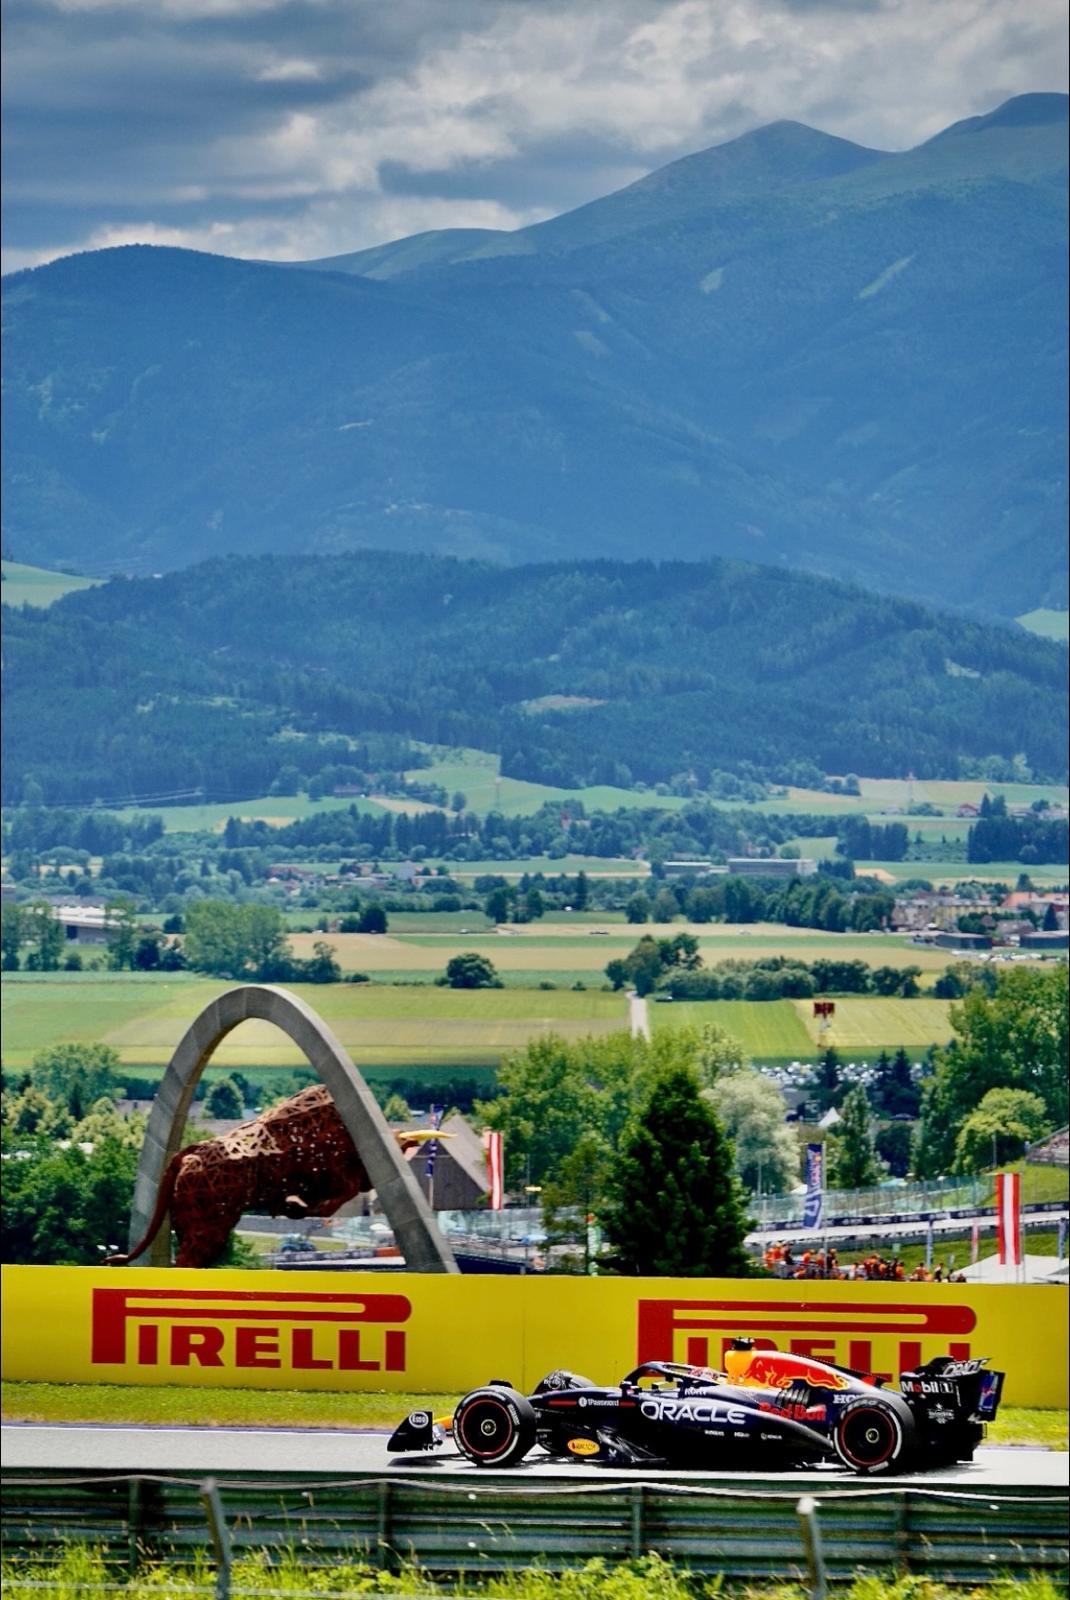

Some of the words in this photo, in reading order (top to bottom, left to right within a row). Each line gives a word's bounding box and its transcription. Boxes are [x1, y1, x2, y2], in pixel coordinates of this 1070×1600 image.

[92, 1288, 412, 1372] PIRELLI
[901, 1381, 940, 1393] Mobil
[641, 1401, 746, 1425] ORACLE
